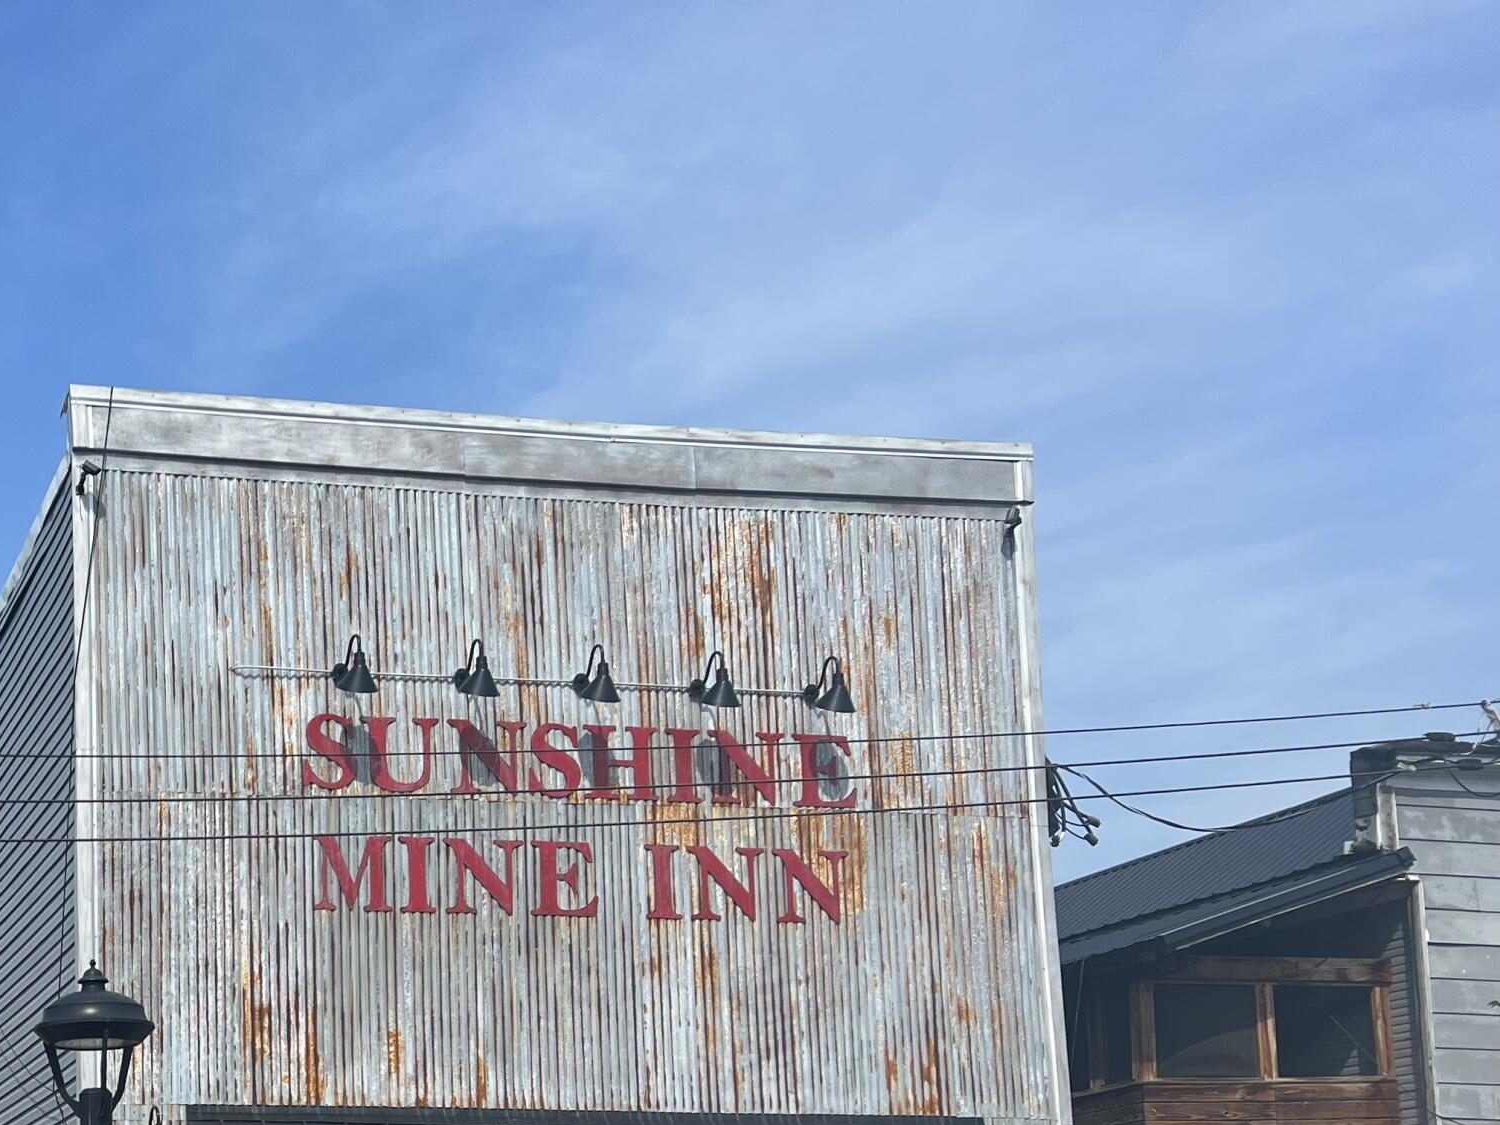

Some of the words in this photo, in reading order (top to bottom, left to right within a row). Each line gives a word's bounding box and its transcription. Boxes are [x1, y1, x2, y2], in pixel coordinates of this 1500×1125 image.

[302, 713, 859, 808] SUNSHINE
[313, 836, 599, 918] MINE
[644, 843, 849, 925] INN
